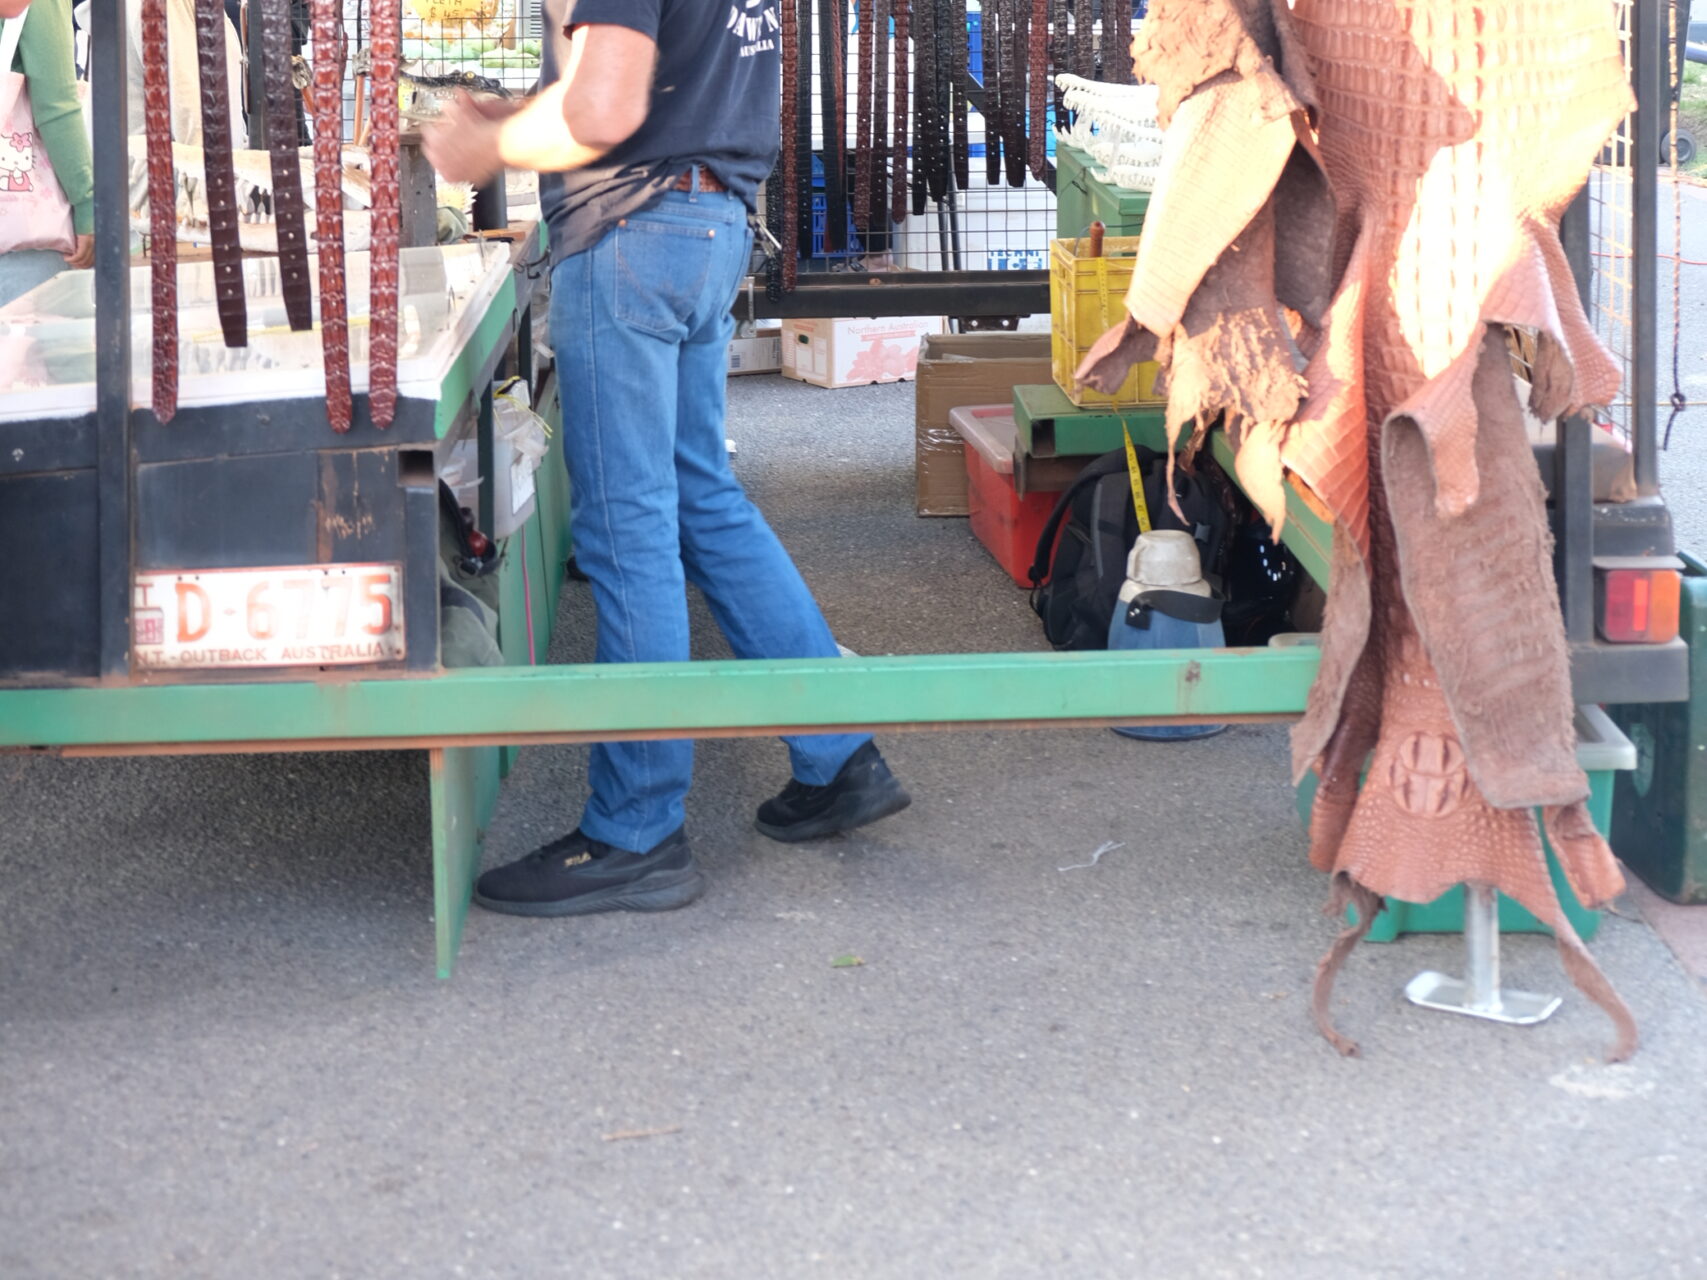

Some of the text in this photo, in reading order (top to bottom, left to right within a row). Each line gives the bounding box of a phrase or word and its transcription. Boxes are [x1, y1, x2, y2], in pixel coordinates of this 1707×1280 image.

[847, 324, 886, 335] Northern
[180, 647, 267, 664] OUTBACK
[281, 641, 385, 661] AUSTRALIA
